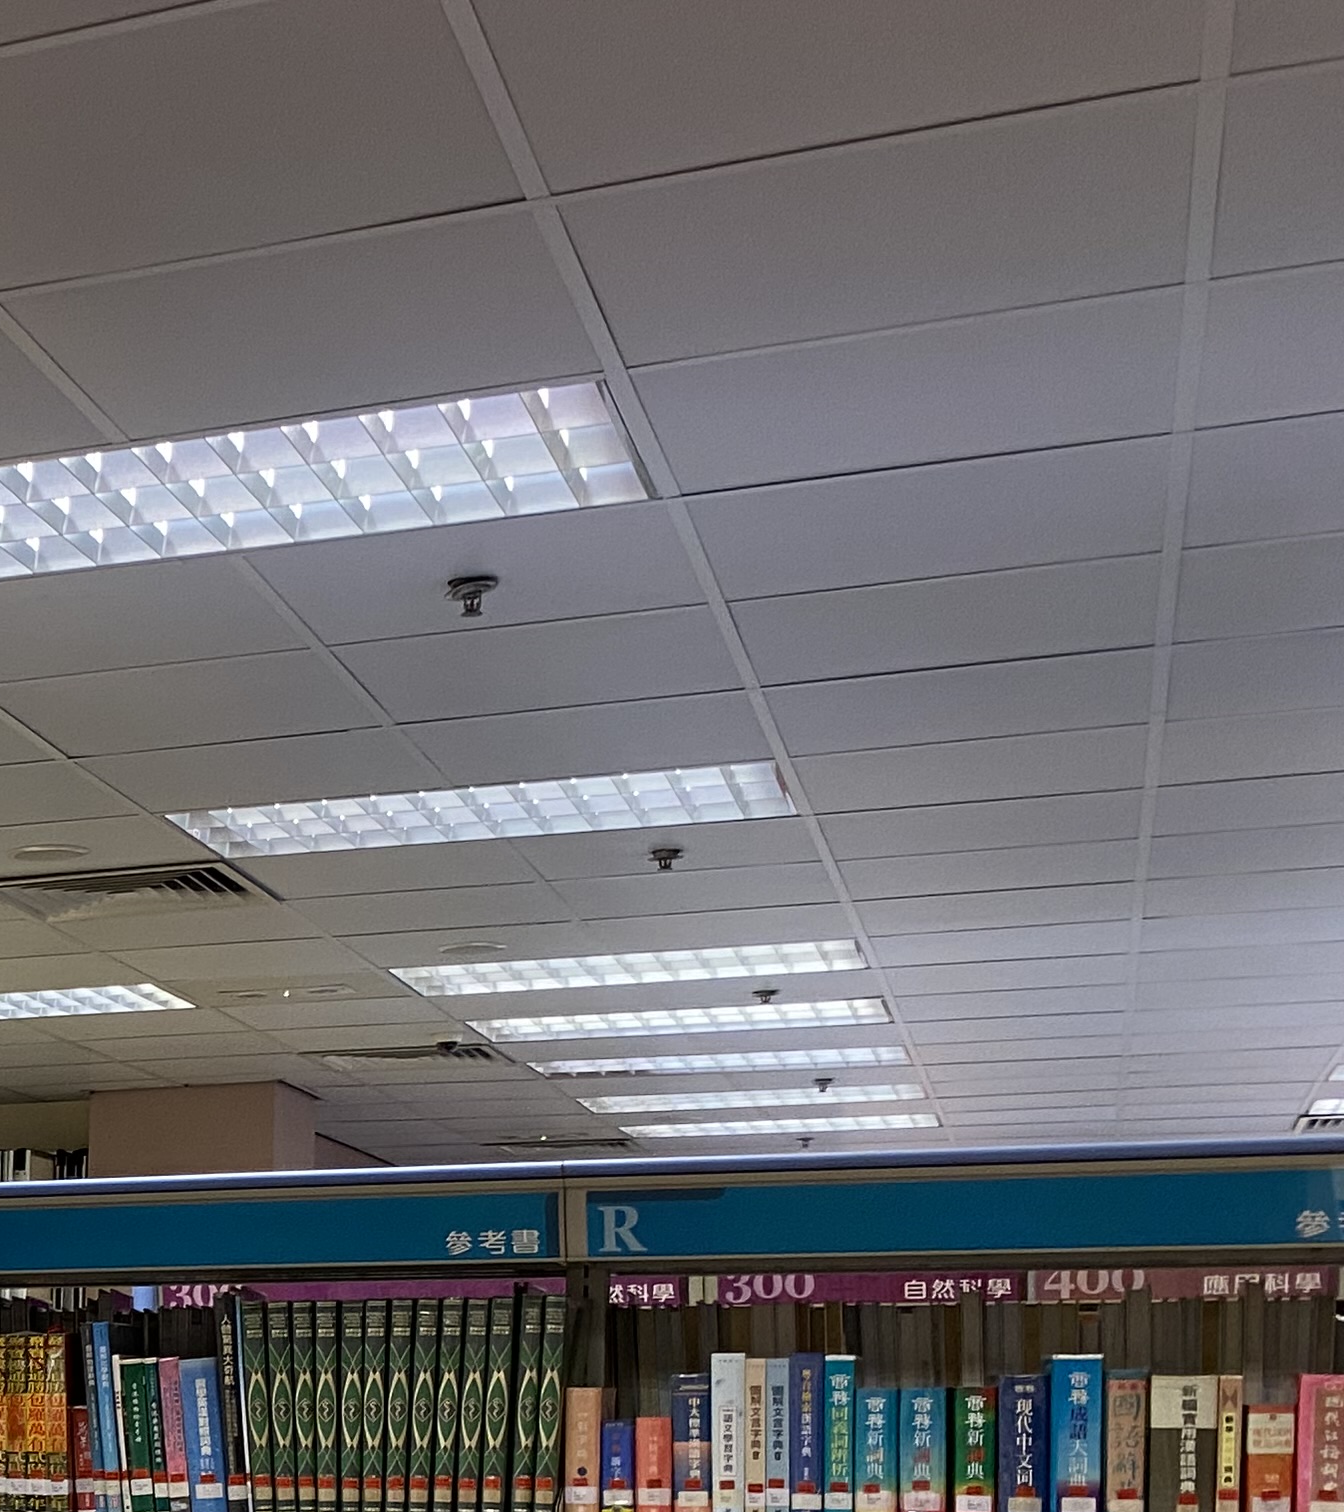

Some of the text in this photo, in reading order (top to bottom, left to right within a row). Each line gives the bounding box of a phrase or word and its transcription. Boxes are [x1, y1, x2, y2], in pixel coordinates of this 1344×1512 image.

[598, 1205, 648, 1253] R
[1295, 1209, 1344, 1238] 參
[444, 1229, 541, 1256] 參考書
[169, 1284, 243, 1309] 30
[725, 1274, 815, 1303] 300
[1043, 1269, 1145, 1300] 400
